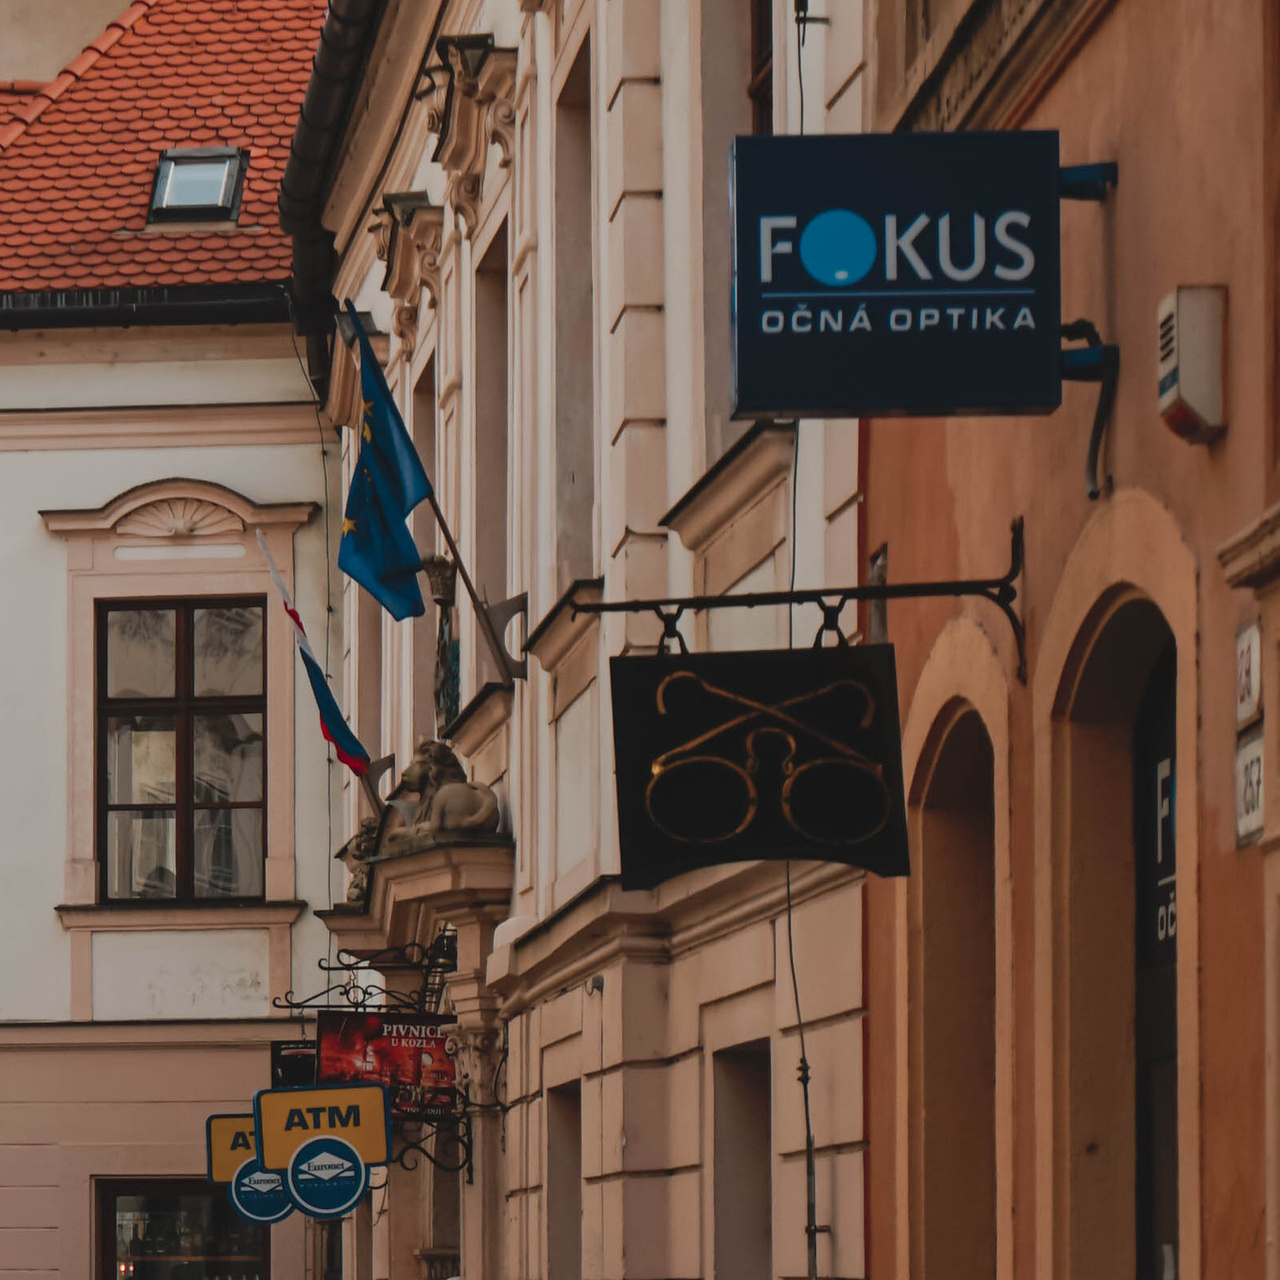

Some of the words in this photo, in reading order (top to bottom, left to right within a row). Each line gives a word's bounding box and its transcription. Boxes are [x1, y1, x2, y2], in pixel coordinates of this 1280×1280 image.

[761, 303, 872, 333] OČNÁ
[889, 307, 1036, 332] OPTIKA
[391, 1038, 399, 1047] U
[401, 1039, 436, 1048] KOZLA
[284, 1105, 361, 1131] ATM
[230, 1131, 255, 1151] A
[307, 1162, 345, 1172] Euronet
